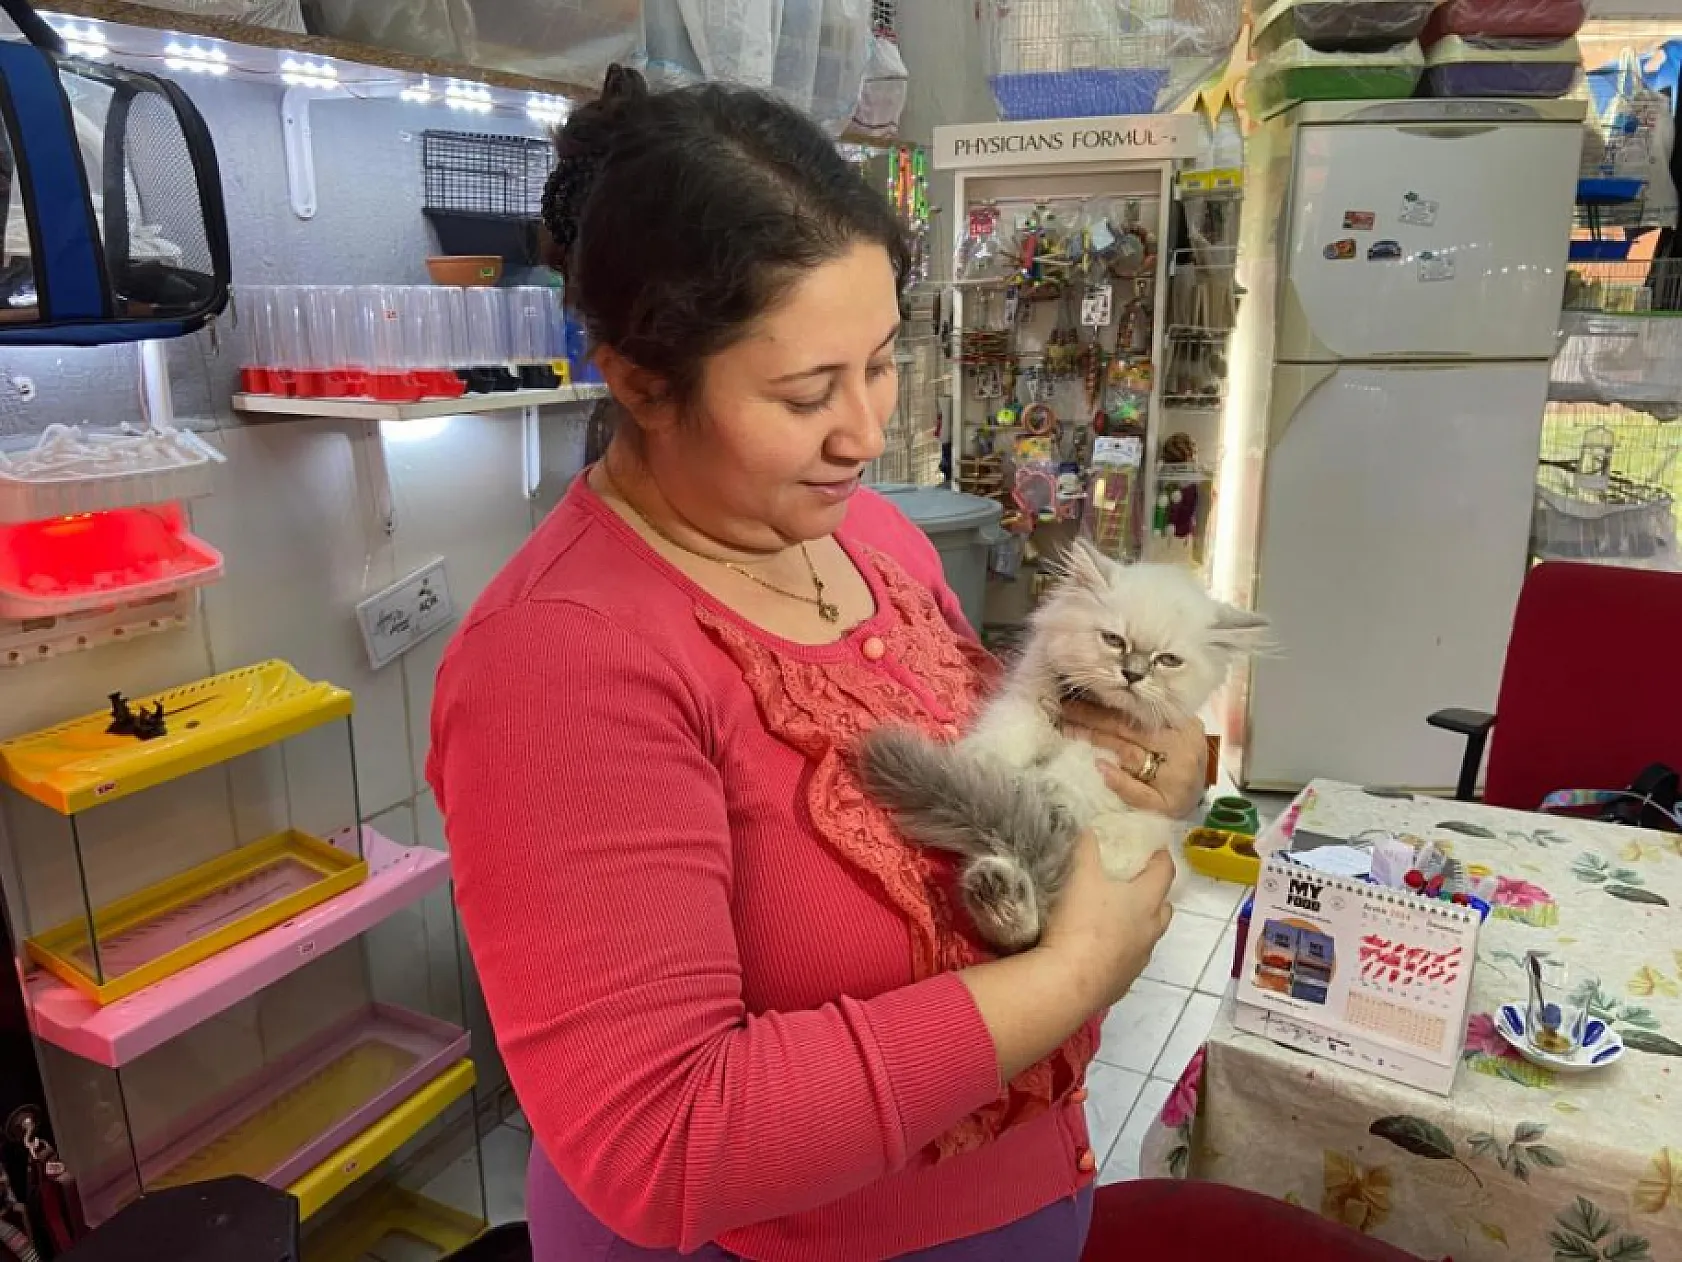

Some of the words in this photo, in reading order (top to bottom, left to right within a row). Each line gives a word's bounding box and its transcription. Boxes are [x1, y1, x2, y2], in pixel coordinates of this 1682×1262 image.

[954, 131, 1063, 156] PHYSICIANS
[1072, 128, 1168, 149] FORMUL
[1289, 878, 1324, 899] MY
